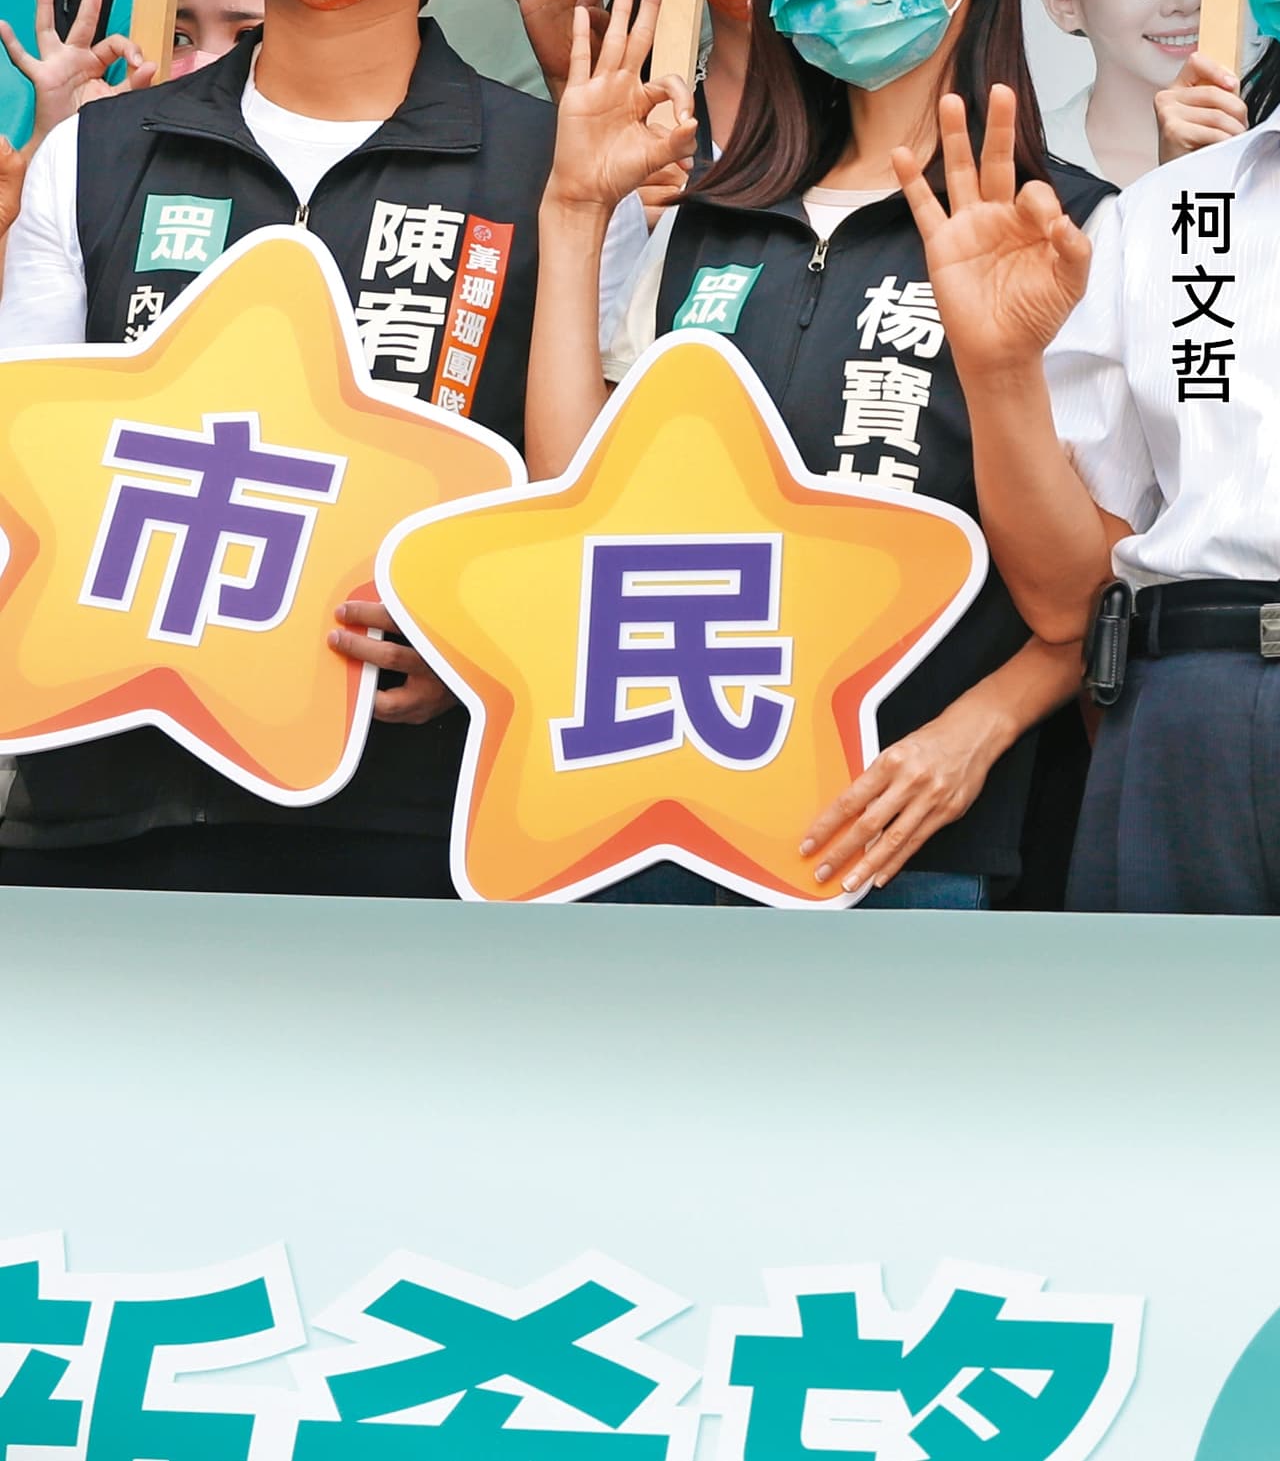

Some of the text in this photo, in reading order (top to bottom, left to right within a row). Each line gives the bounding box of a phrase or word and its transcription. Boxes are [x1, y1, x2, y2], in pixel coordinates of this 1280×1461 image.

[353, 199, 468, 400] 陳宥
[84, 418, 342, 642] 市
[555, 538, 788, 765] 民
